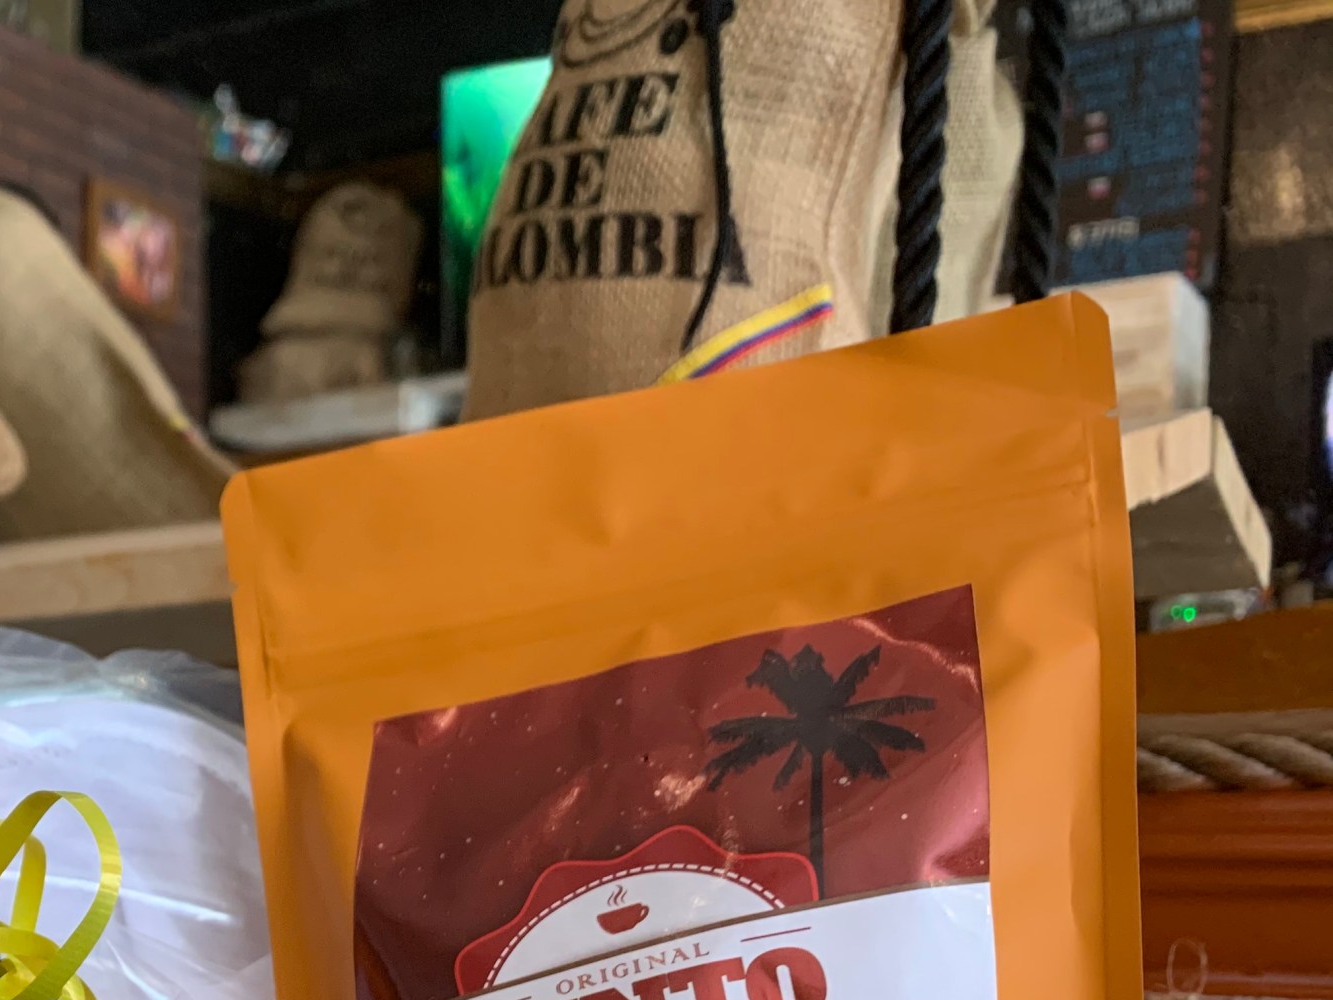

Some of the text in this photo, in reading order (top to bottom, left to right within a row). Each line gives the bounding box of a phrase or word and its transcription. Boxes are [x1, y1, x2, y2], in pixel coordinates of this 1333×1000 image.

[510, 148, 610, 216] DE
[479, 210, 751, 289] LOMBIA
[556, 942, 710, 995] ORIGINAL
